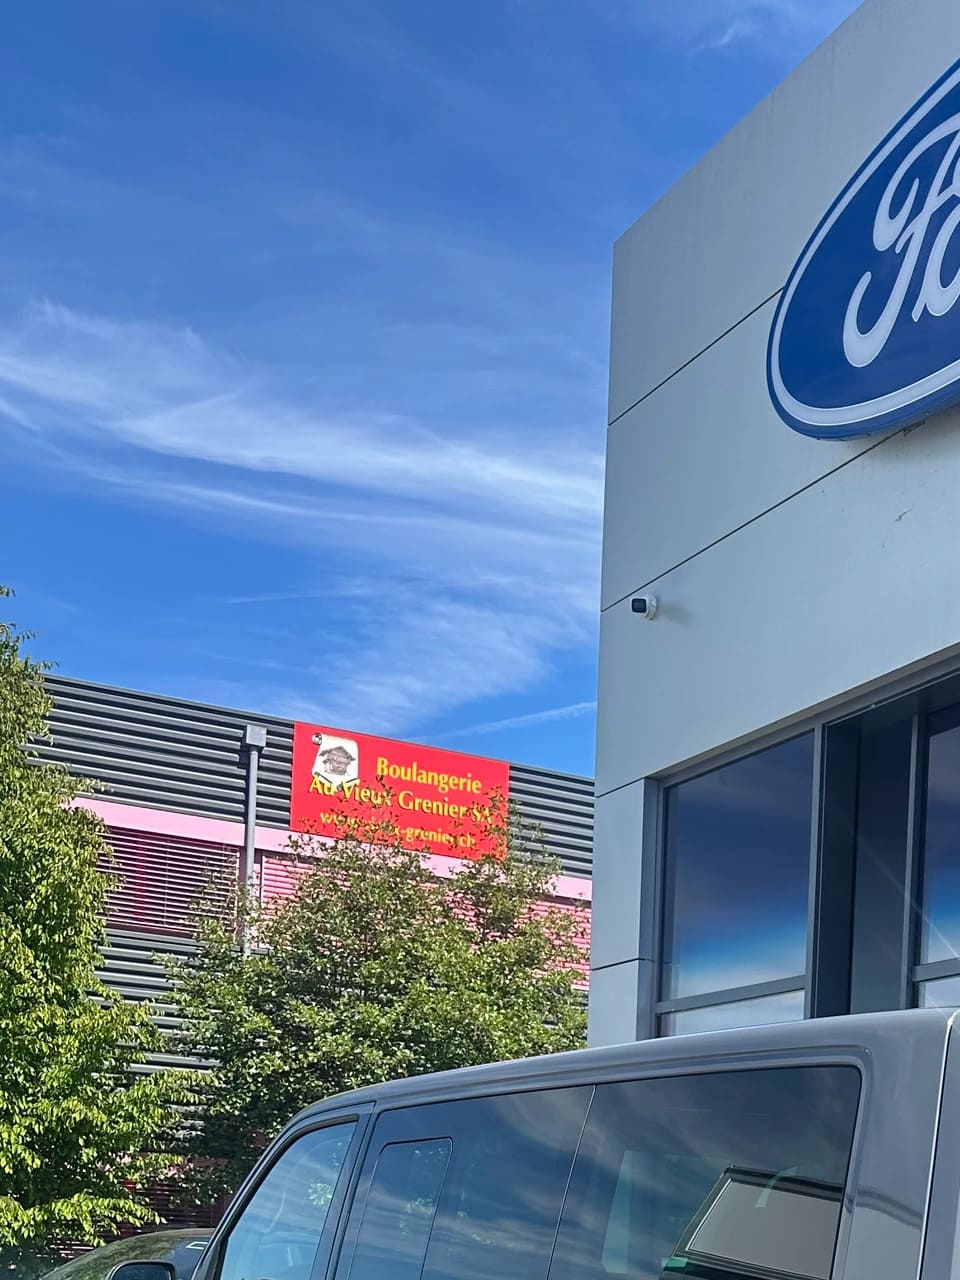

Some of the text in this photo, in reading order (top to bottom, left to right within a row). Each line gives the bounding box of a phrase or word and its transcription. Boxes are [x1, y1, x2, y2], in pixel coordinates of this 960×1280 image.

[376, 757, 482, 794] Boulangerie
[309, 775, 492, 824] Au Vieux Grenier SA
